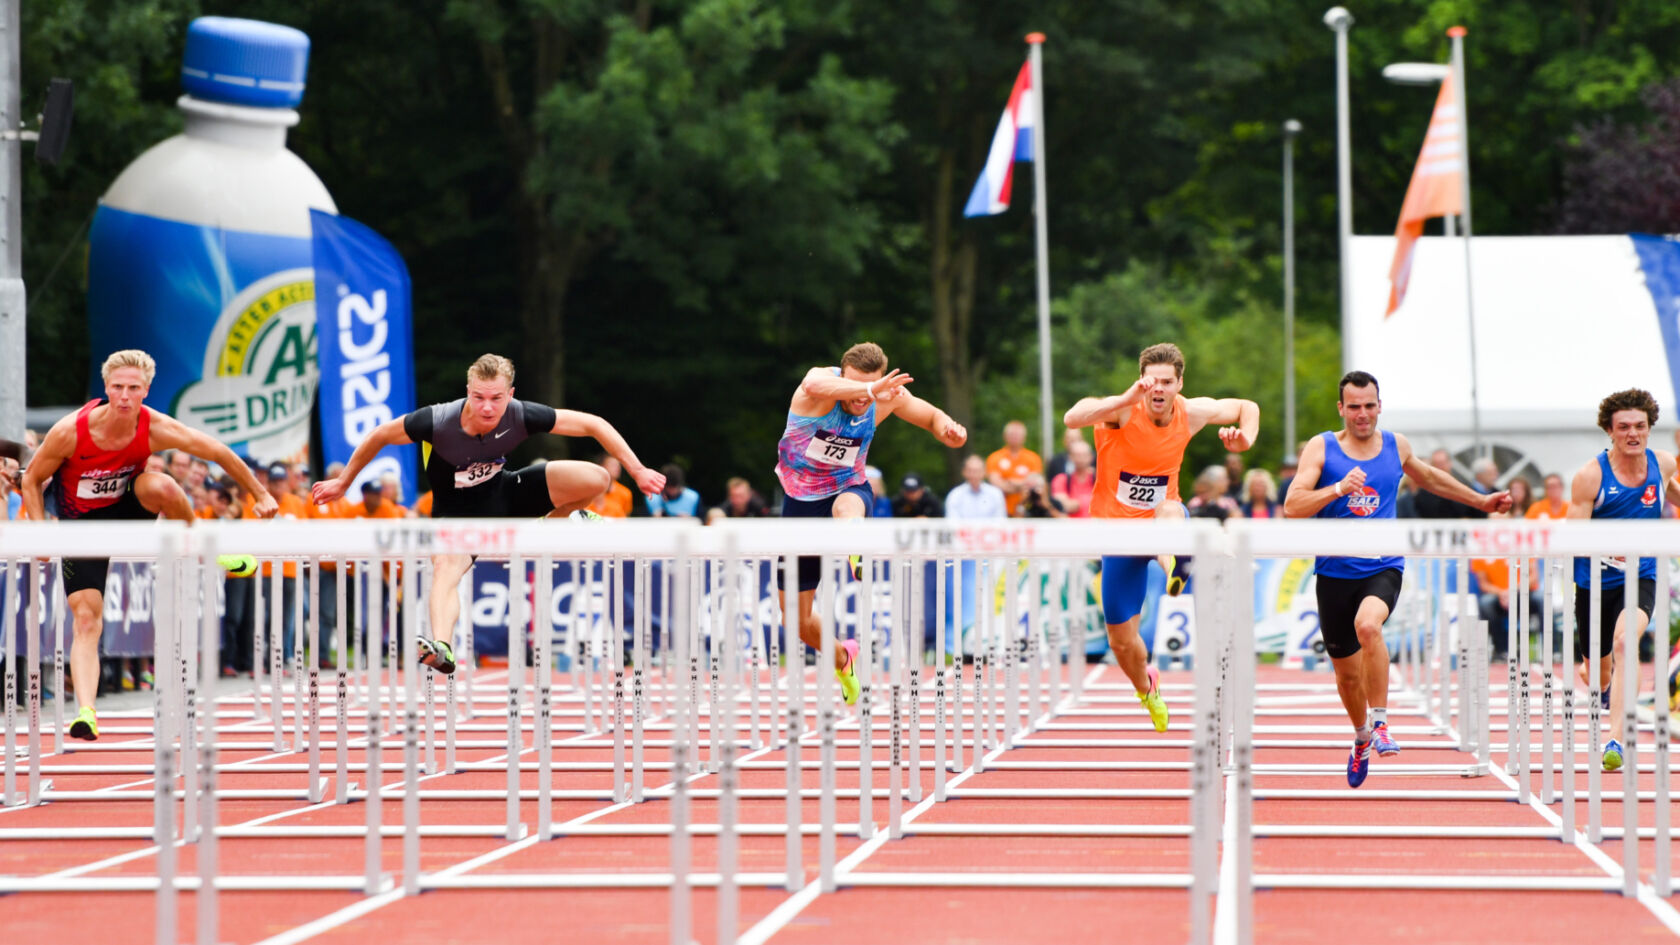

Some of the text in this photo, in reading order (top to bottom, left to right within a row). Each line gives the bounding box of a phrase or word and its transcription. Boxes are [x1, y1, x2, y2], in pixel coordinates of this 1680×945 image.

[230, 284, 314, 354] AFTER ACTI
[246, 384, 311, 428] DRIN
[823, 445, 847, 460] 173
[468, 464, 493, 481] 332
[1138, 477, 1159, 485] asics
[92, 480, 117, 494] 344
[1128, 487, 1155, 502] 222
[375, 528, 517, 552] UTRECHT
[893, 527, 1037, 551] UTRECHT
[1407, 527, 1552, 552] UTRECHT
[1167, 612, 1190, 649] 3
[1298, 610, 1321, 650] 2
